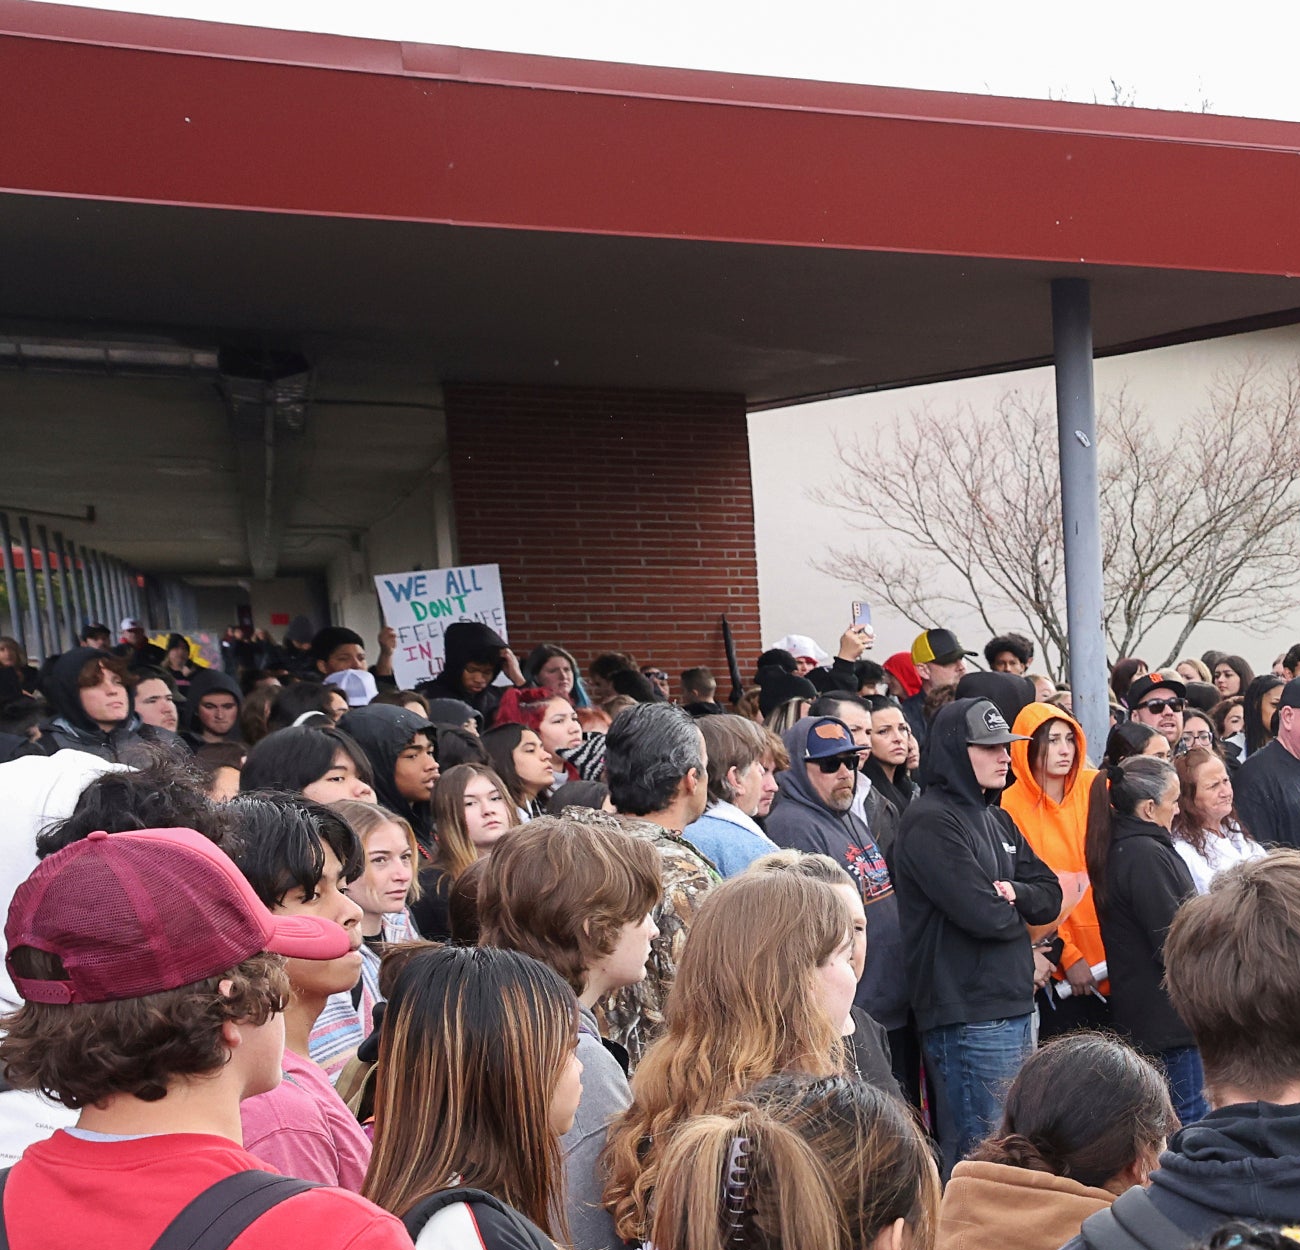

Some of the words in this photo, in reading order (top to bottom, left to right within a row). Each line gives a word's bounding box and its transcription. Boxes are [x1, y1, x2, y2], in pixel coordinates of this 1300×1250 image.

[384, 575, 427, 603] WE
[445, 568, 483, 596] ALL
[403, 640, 434, 662] IN
